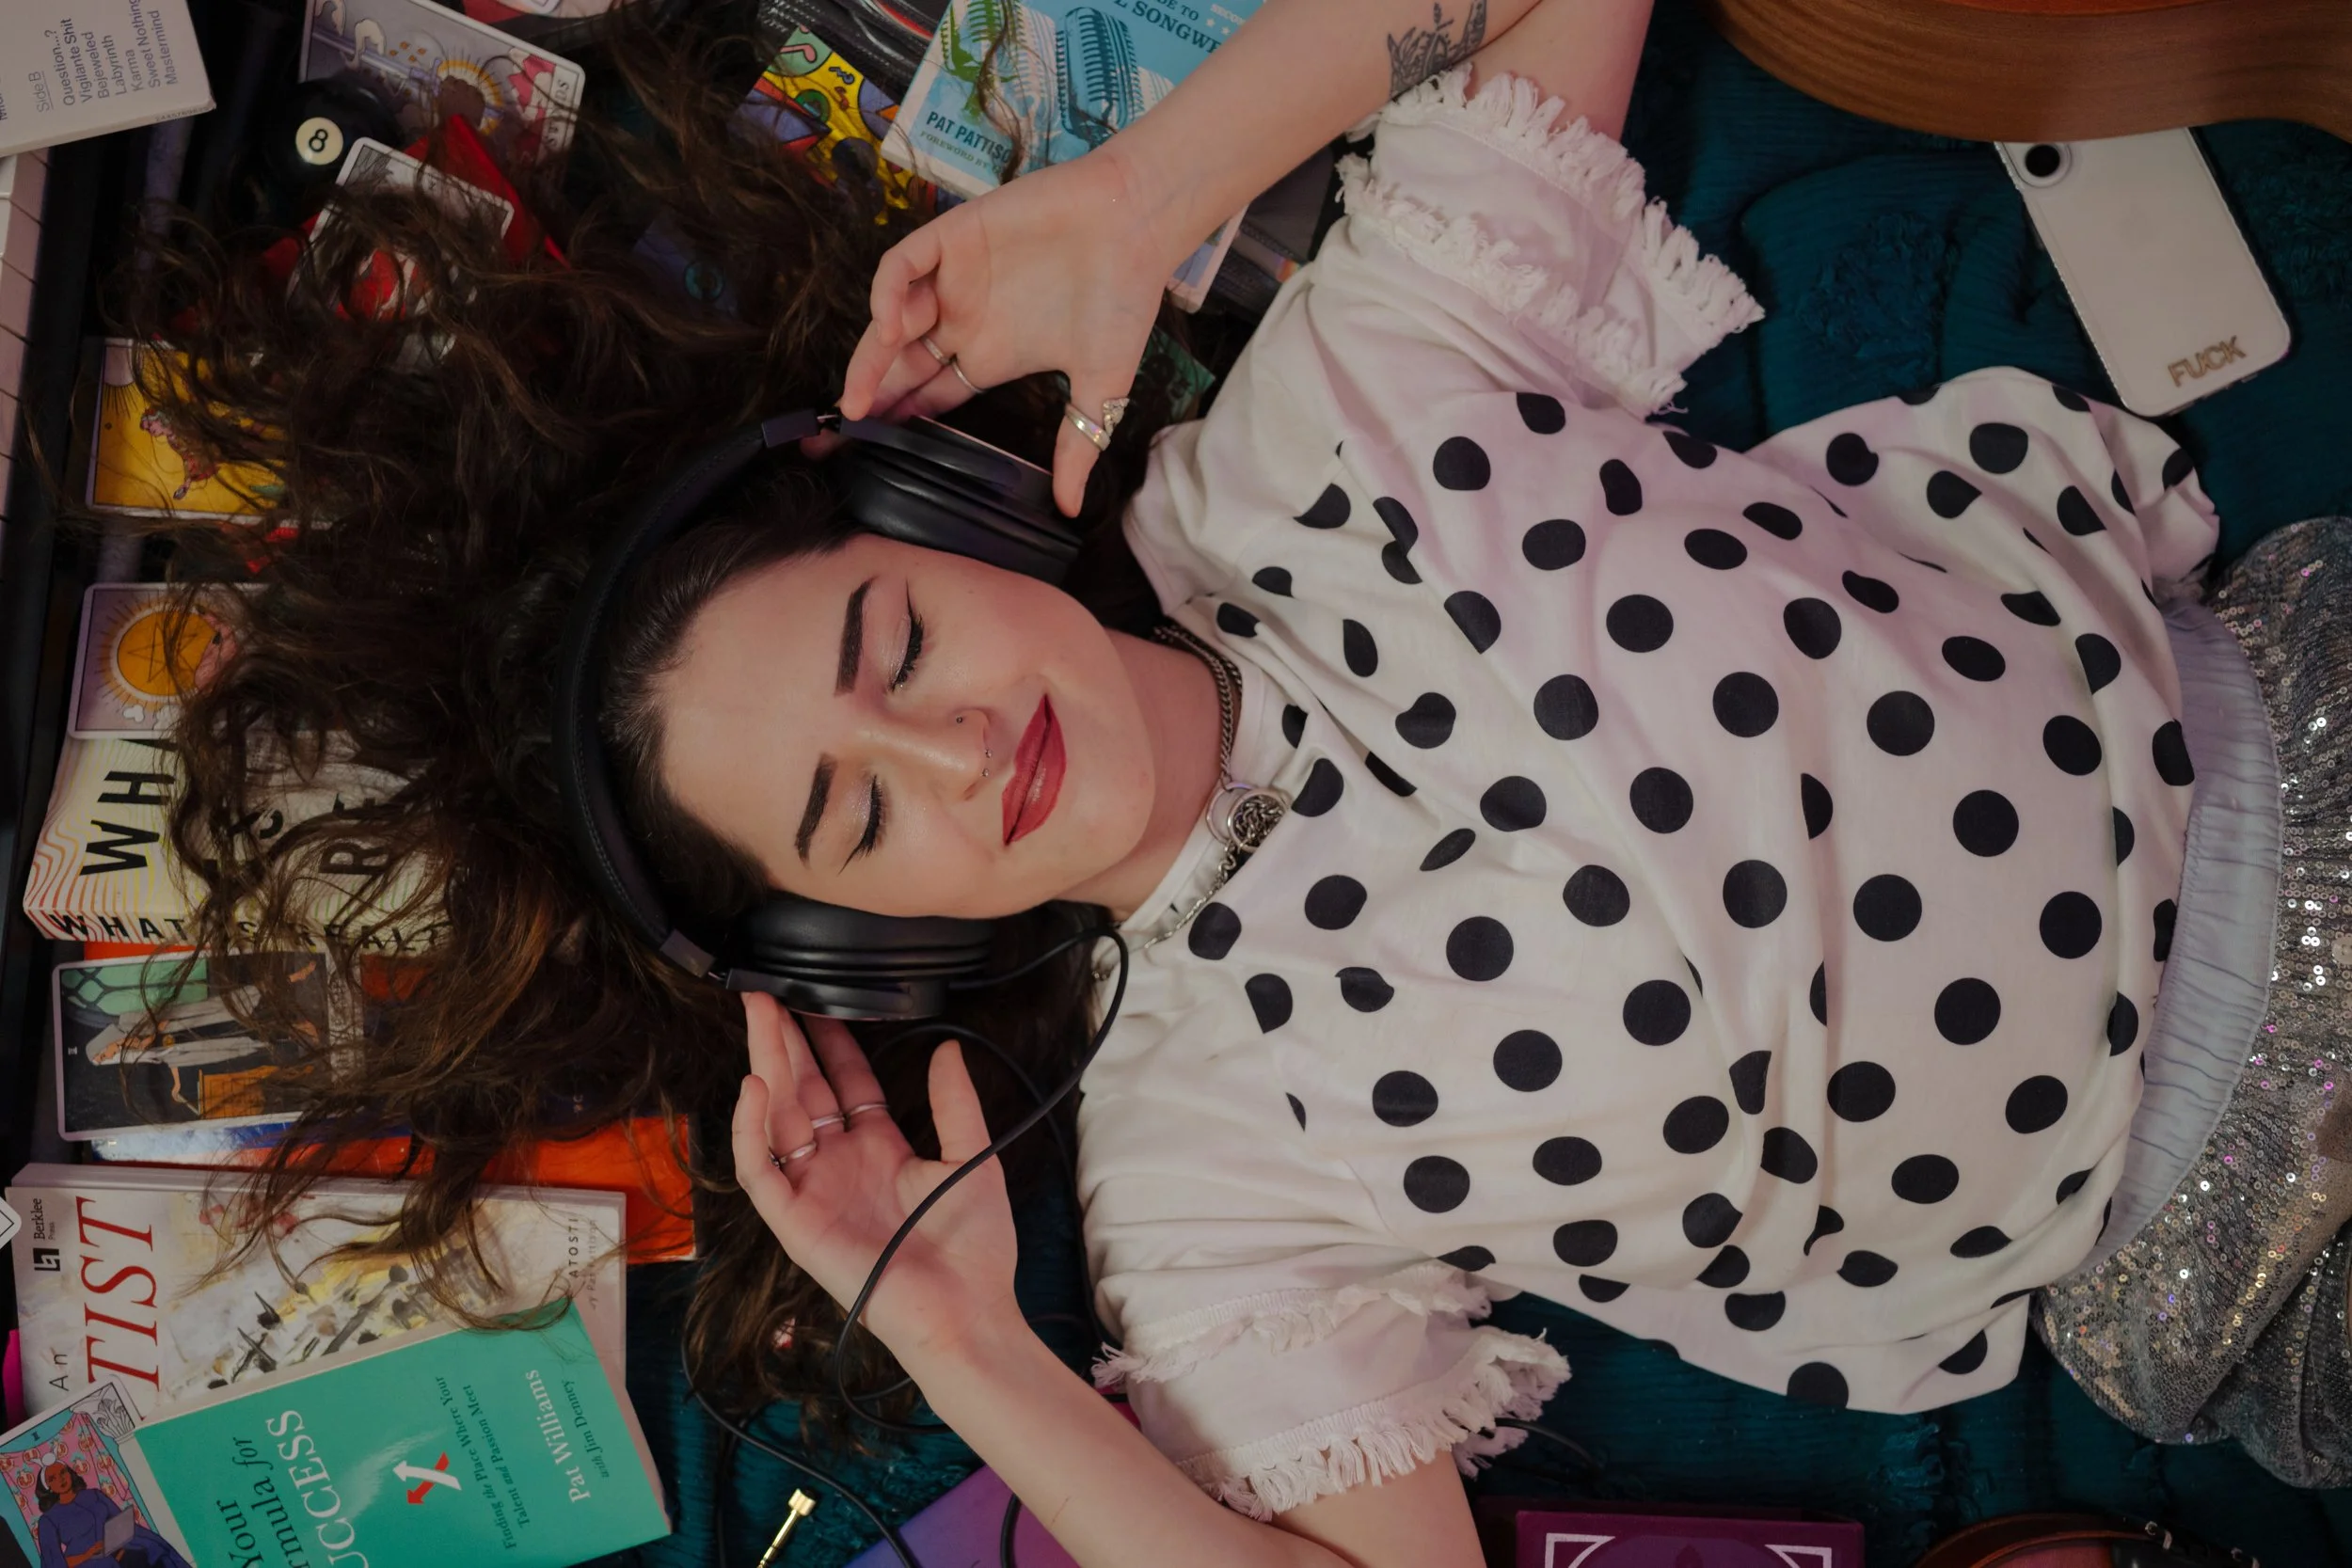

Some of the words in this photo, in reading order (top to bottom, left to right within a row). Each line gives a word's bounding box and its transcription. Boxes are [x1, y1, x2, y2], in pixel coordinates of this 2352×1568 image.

[60, 18, 77, 45] Shit
[1180, 5, 1200, 21] TO
[81, 31, 110, 99] Bejeweled
[102, 34, 127, 96] Labyrinth
[148, 9, 178, 86] Mastermind
[28, 71, 41, 82] B
[44, 29, 75, 106] Question...?
[70, 45, 93, 103] Vigilante
[125, 49, 145, 92] Karma
[142, 49, 161, 88] Sweet
[33, 83, 50, 113] Side
[309, 128, 328, 152] 8
[920, 131, 974, 162] FOREWORD
[975, 158, 989, 169] BY
[926, 111, 955, 134] PAT
[955, 125, 1013, 164] PATTISO
[2168, 335, 2247, 388] FUCK
[49, 913, 188, 941] WHAT
[30, 1197, 46, 1240] Berklee
[75, 1195, 160, 1421] TIST
[49, 1354, 70, 1392] An
[435, 1375, 453, 1406] Your
[463, 1384, 484, 1417] Meet
[525, 1370, 573, 1465] Williams
[562, 1379, 588, 1428] Denney
[450, 1406, 472, 1448] Where
[478, 1418, 504, 1464] Passion
[583, 1430, 603, 1453] Jim
[231, 1436, 274, 1471] for
[469, 1448, 488, 1482] Place
[591, 1453, 610, 1479] with
[482, 1482, 497, 1499] the
[497, 1465, 514, 1486] and
[564, 1465, 591, 1503] Pat
[491, 1500, 517, 1550] Finding
[508, 1487, 531, 1528] Talent
[216, 1500, 264, 1568] Your
